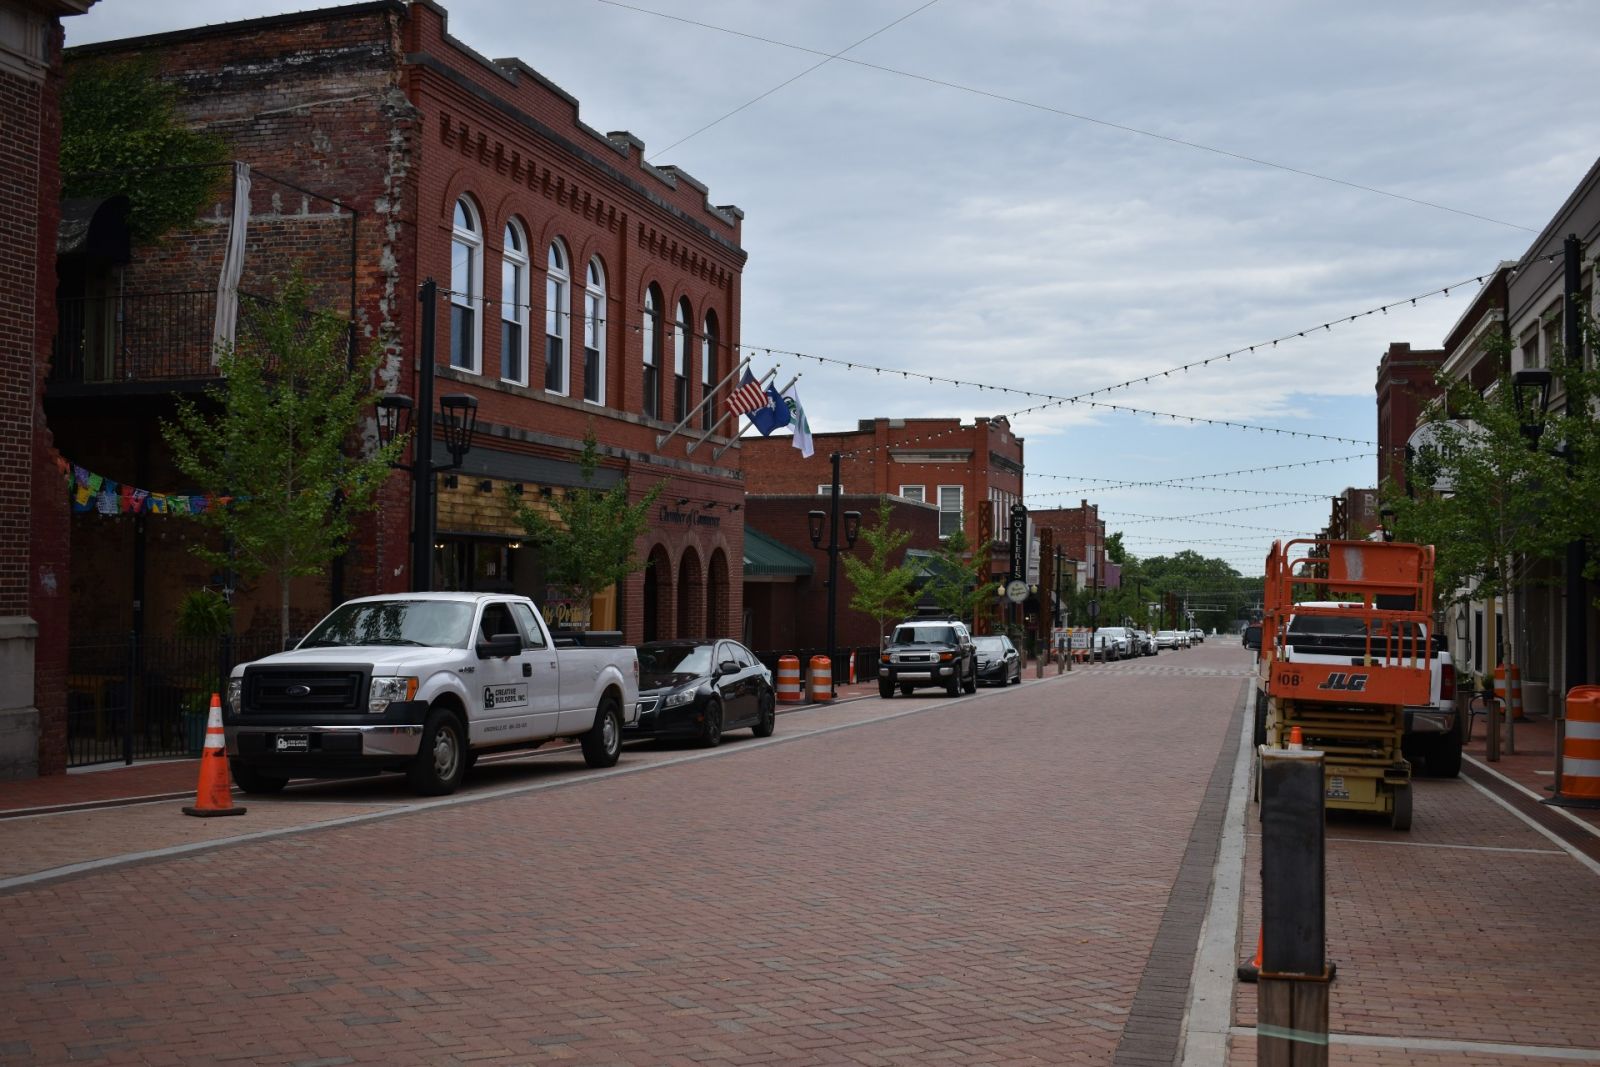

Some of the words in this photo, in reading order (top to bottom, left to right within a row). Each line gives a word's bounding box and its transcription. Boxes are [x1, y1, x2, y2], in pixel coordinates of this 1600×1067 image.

[1014, 521, 1022, 579] GALLERIES
[1318, 672, 1368, 691] JLG
[495, 688, 516, 696] CREATIVE
